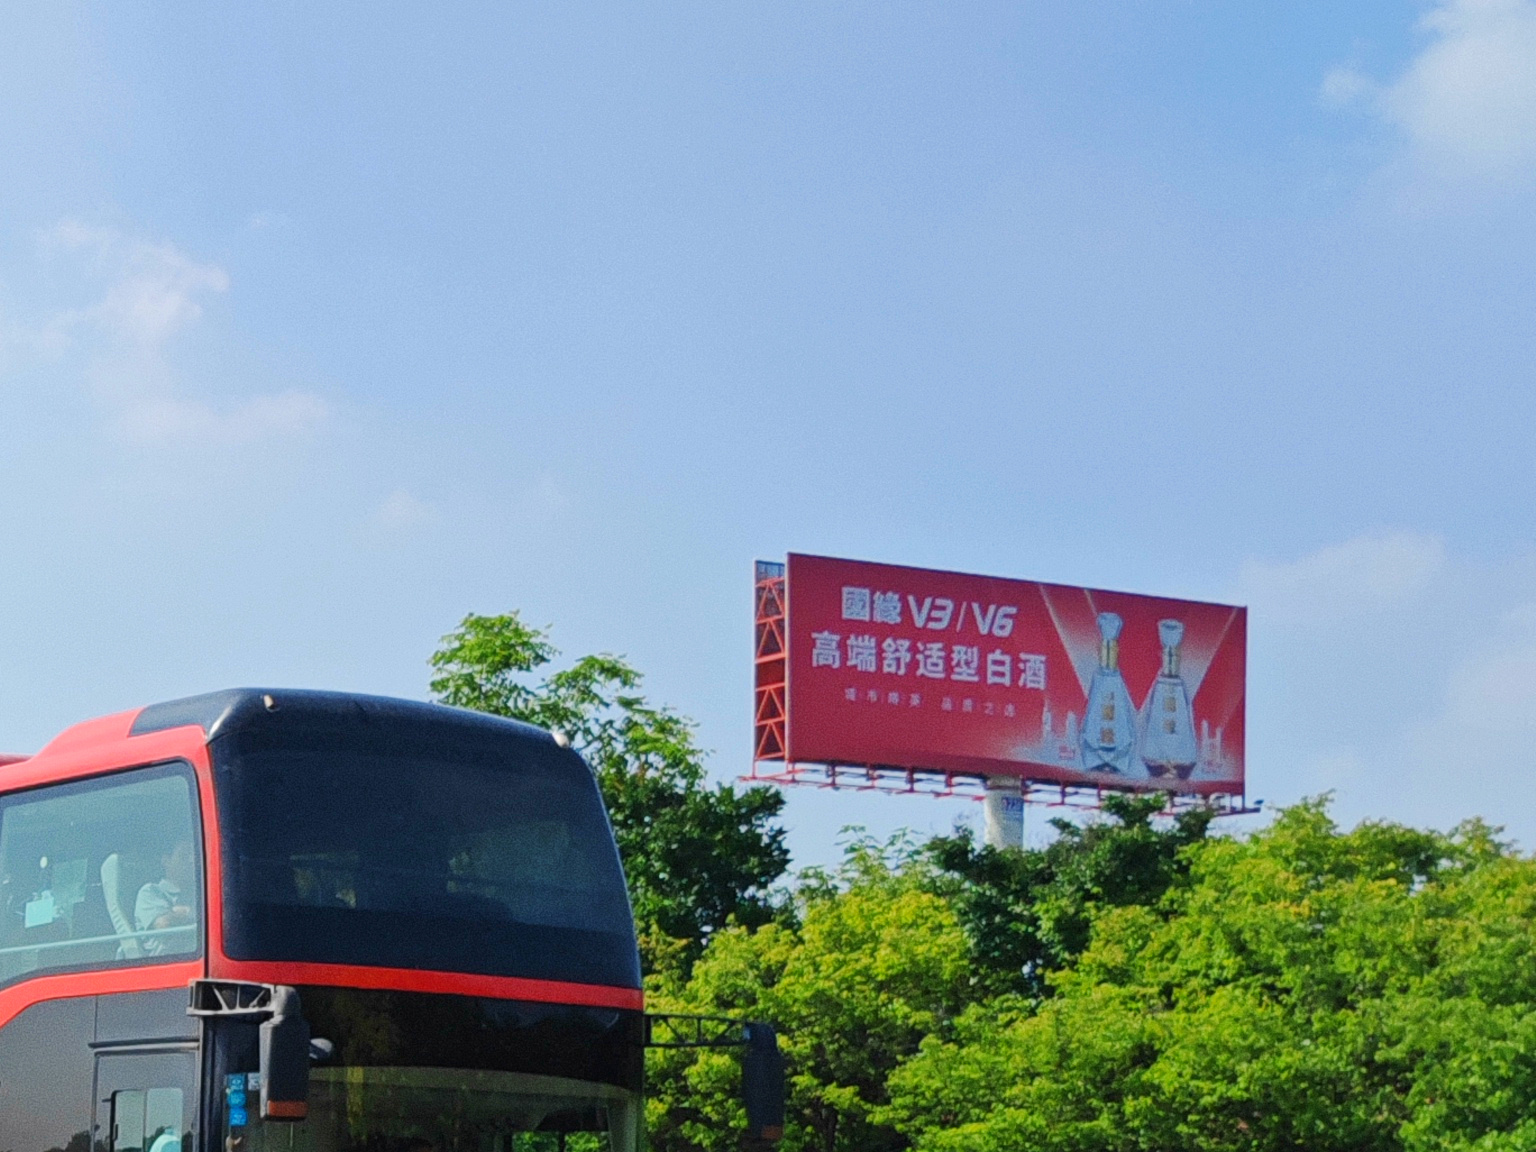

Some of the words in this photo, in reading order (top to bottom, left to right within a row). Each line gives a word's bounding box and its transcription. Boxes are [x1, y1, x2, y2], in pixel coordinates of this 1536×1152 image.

[811, 630, 1047, 691] 高端舒适型白酒
